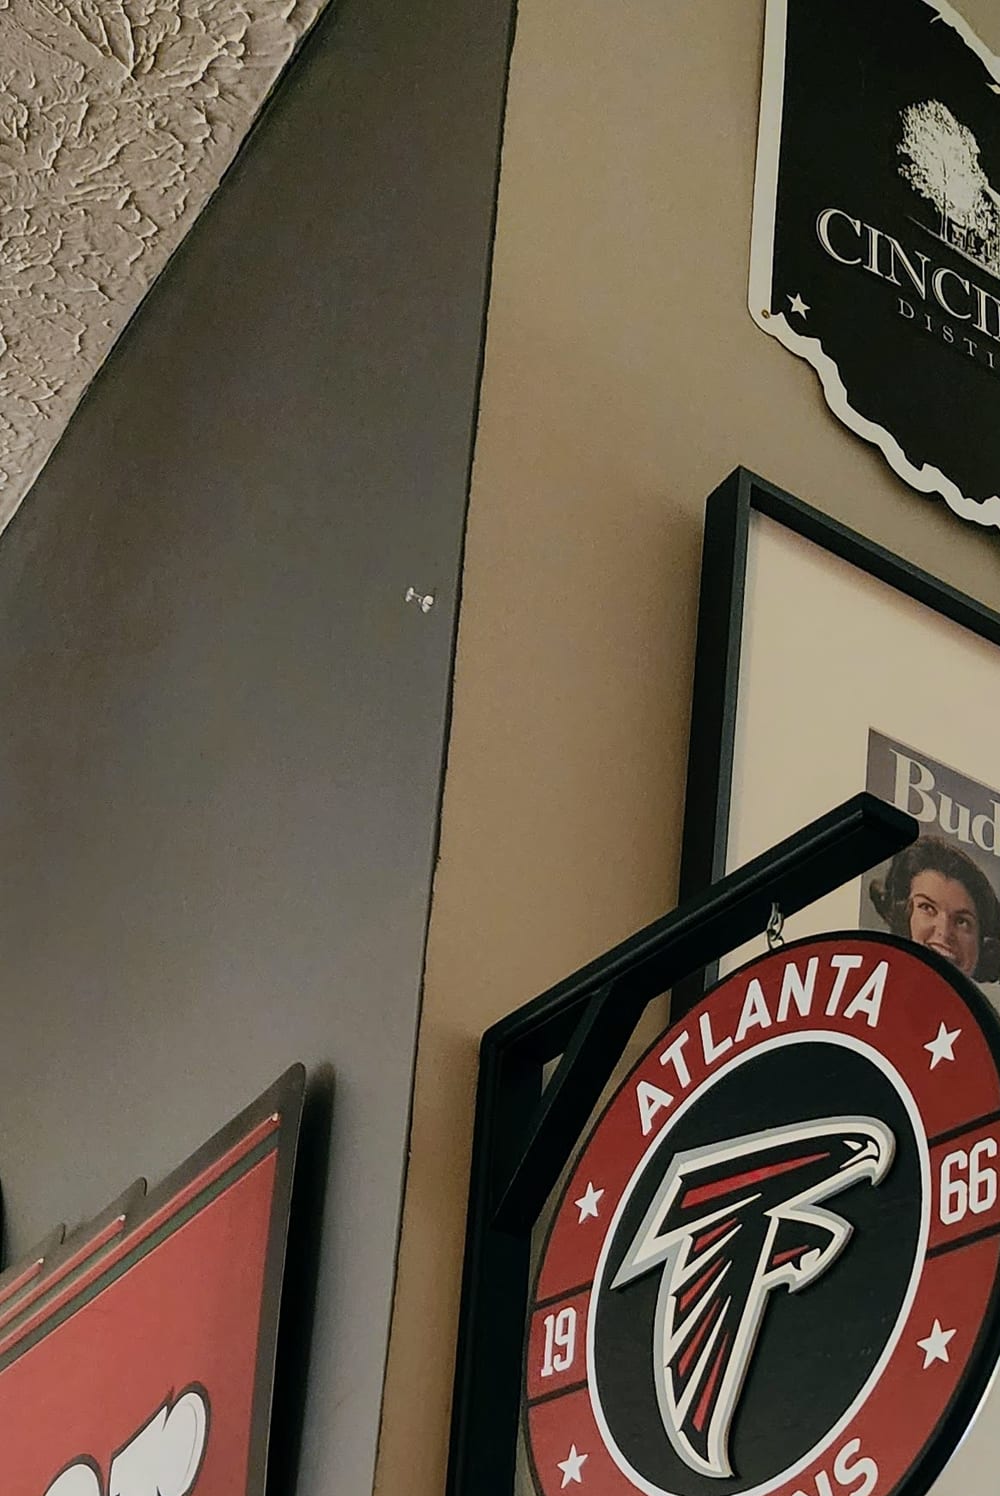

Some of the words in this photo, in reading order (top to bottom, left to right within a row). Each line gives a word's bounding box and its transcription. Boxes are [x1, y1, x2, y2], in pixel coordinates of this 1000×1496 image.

[633, 954, 889, 1136] ATLANTA
[938, 1136, 998, 1225] 66
[540, 1305, 577, 1378] 19
